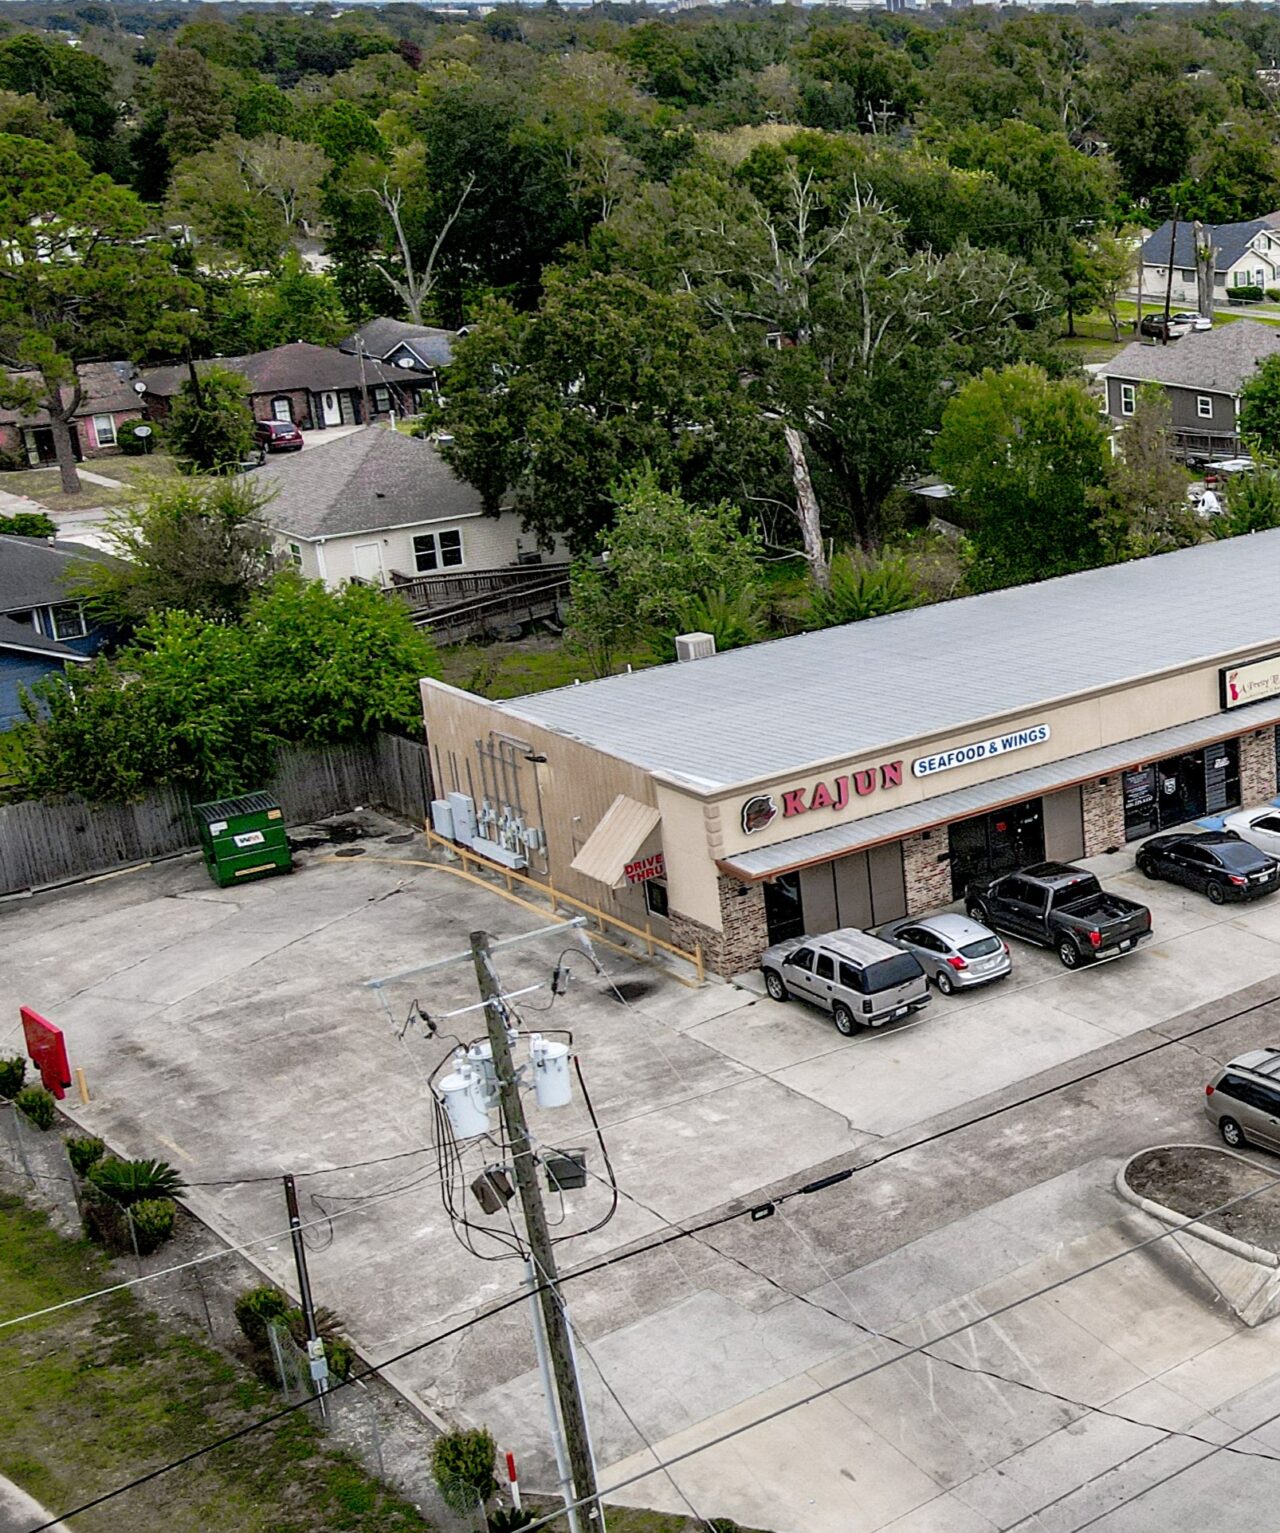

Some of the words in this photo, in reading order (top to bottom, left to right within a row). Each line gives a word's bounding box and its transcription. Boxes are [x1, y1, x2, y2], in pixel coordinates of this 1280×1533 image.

[918, 745, 986, 774] SEAFOOD
[988, 741, 998, 755] &
[1001, 727, 1047, 751] WINGS
[781, 760, 903, 818] KAJUN
[624, 854, 664, 875] DRIVE
[628, 865, 663, 884] THRU
